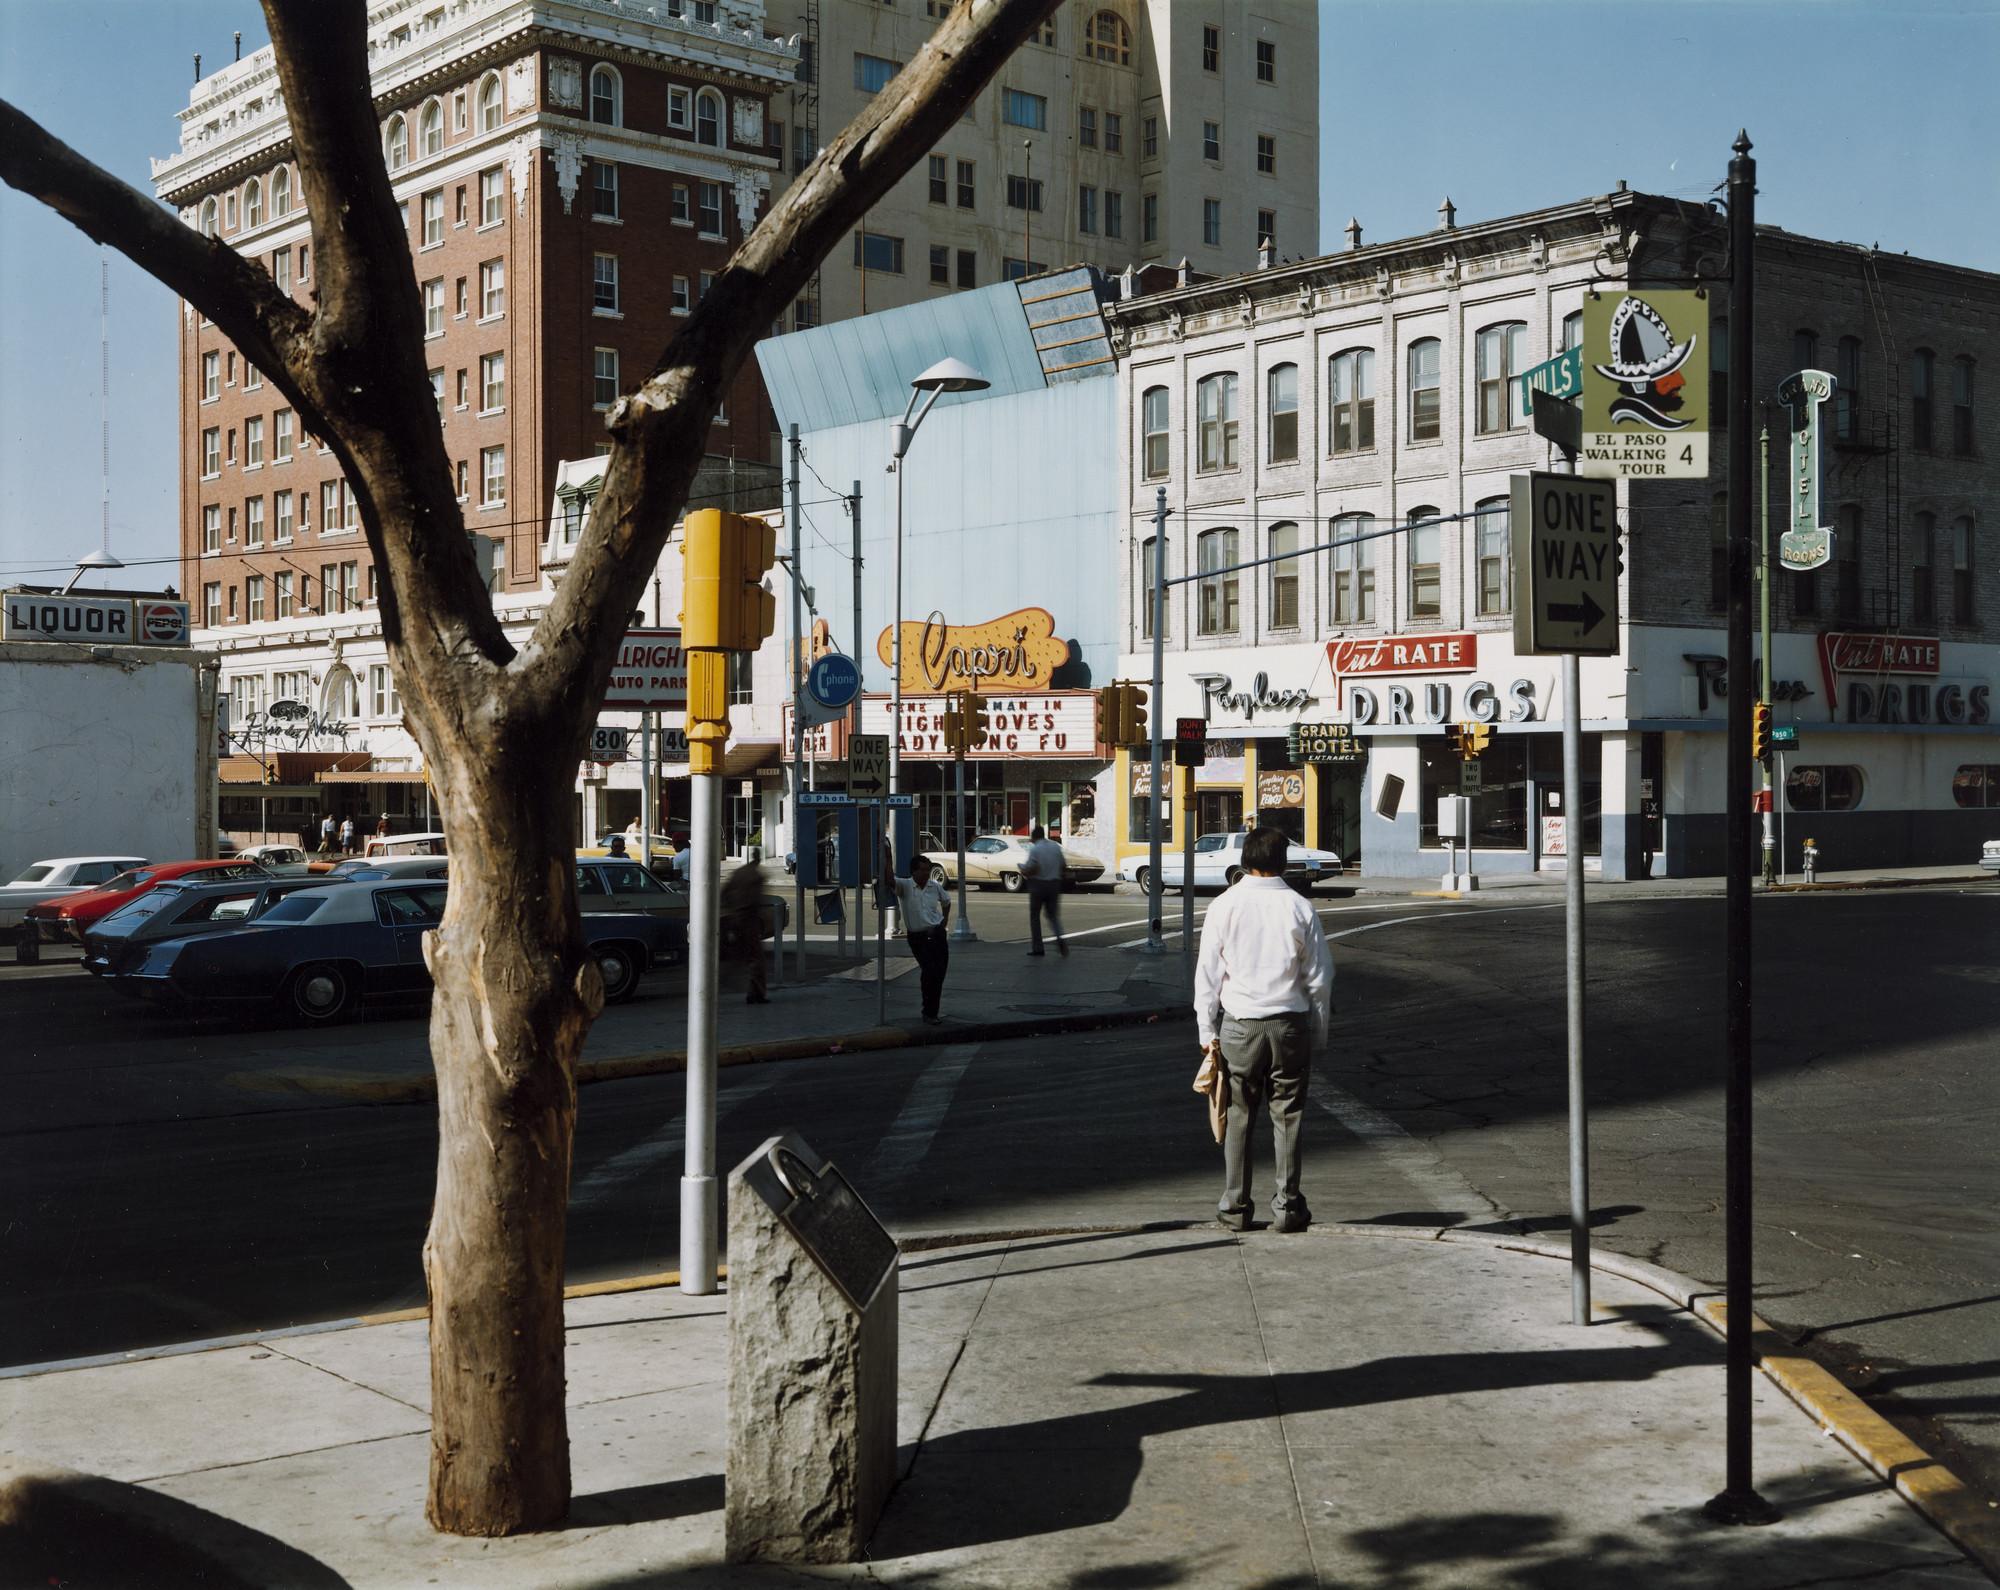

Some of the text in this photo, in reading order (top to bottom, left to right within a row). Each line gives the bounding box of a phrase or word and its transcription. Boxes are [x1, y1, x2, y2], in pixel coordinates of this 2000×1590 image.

[1595, 434, 1667, 446] EL PASO
[1585, 449, 1667, 461] WALKING
[1679, 445, 1693, 466] 4
[1799, 405, 1810, 518] HOTEL
[1619, 464, 1667, 475] TOUR
[1543, 489, 1606, 533] ONE
[1542, 539, 1609, 582] WAY
[1784, 544, 1826, 563] ROOMS
[11, 605, 126, 634] LIQUOR
[146, 616, 183, 630] PEPSI
[921, 610, 1036, 690] Capri
[1332, 636, 1461, 674] Cut RATE
[1832, 632, 1936, 671] Cut RATE
[608, 676, 644, 689] AUTO
[826, 674, 855, 688] phone
[1044, 700, 1062, 711] IN
[1188, 671, 1319, 722] Payless
[1350, 679, 1537, 725] DRUGS
[1848, 683, 1990, 724] DRUGS
[1300, 725, 1349, 737] GRAND
[854, 739, 883, 755] ONE
[900, 734, 939, 751] ADY
[1039, 733, 1067, 751] FU
[1299, 739, 1364, 754] HOTEL
[853, 758, 884, 774] WAY
